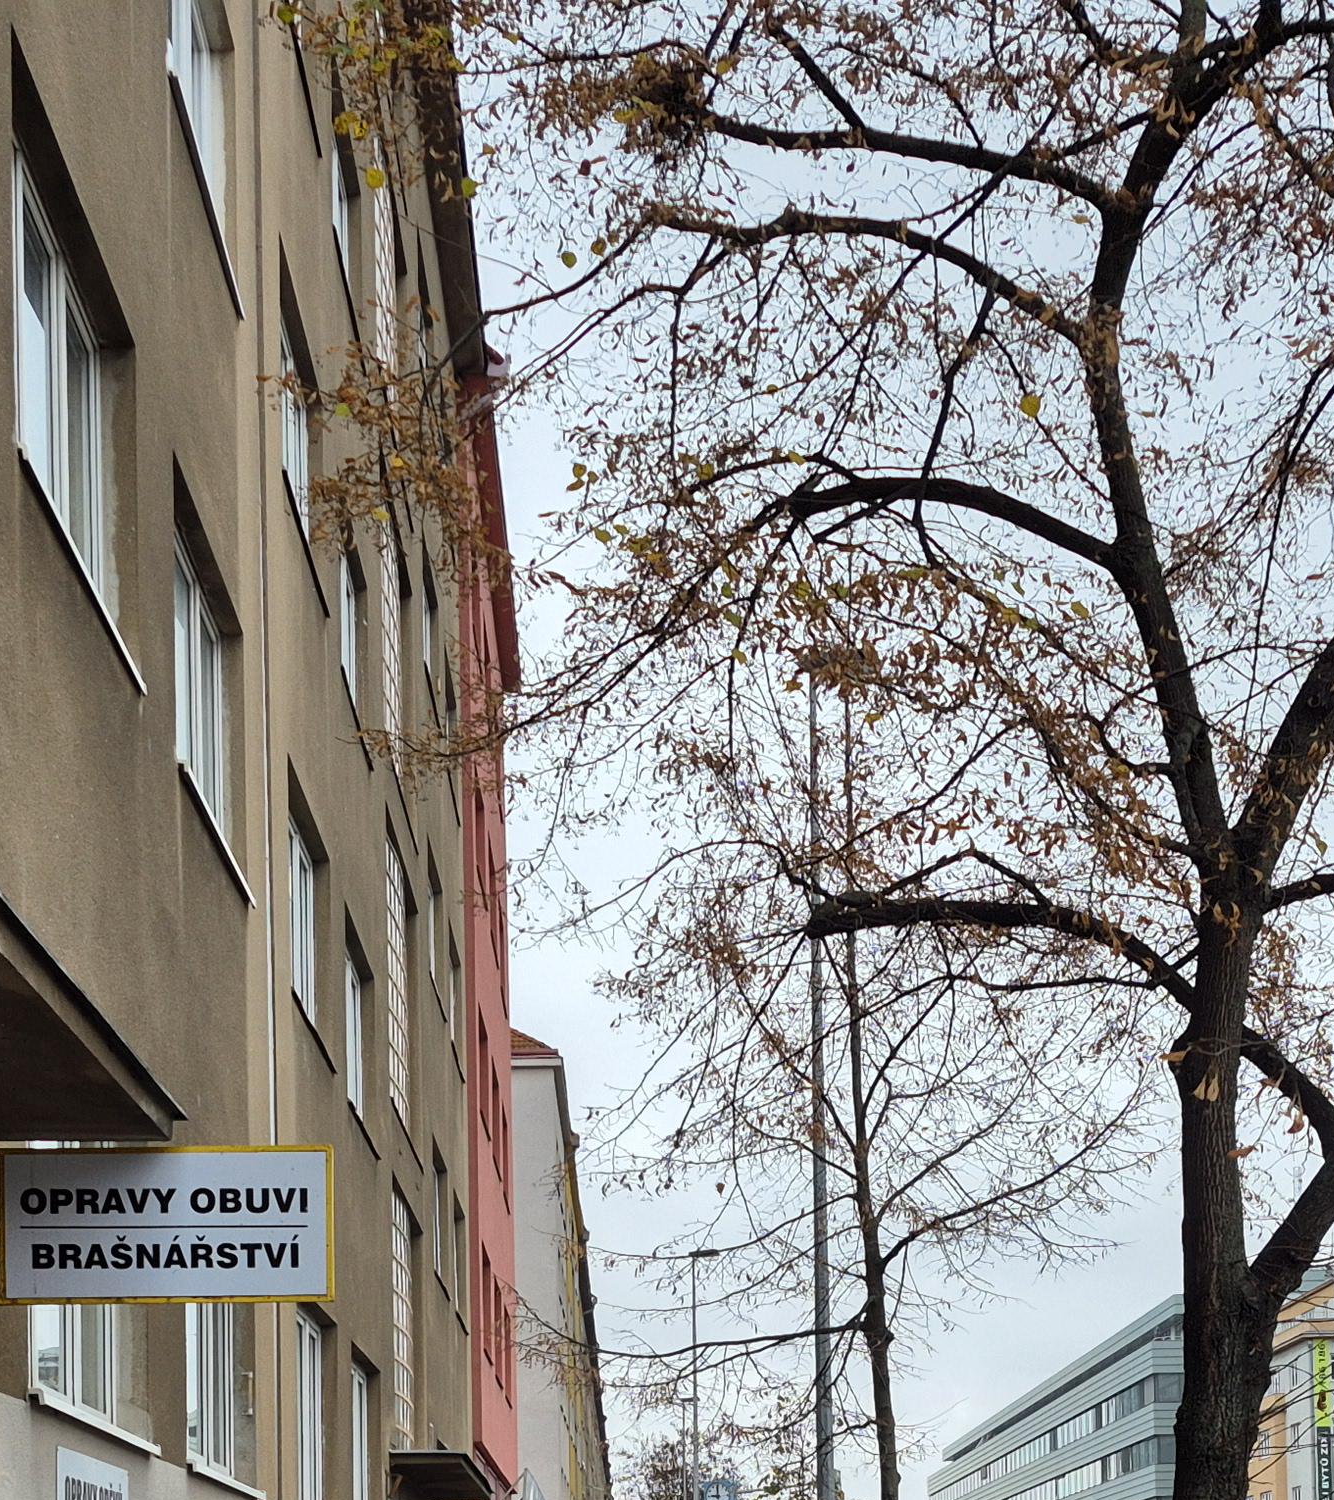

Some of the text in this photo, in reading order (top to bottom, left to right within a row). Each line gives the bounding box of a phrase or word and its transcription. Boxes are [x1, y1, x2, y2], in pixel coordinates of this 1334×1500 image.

[19, 1187, 309, 1215] OPRAVY OBUVI
[31, 1234, 300, 1269] BRAŠNÁŘSTVÍ
